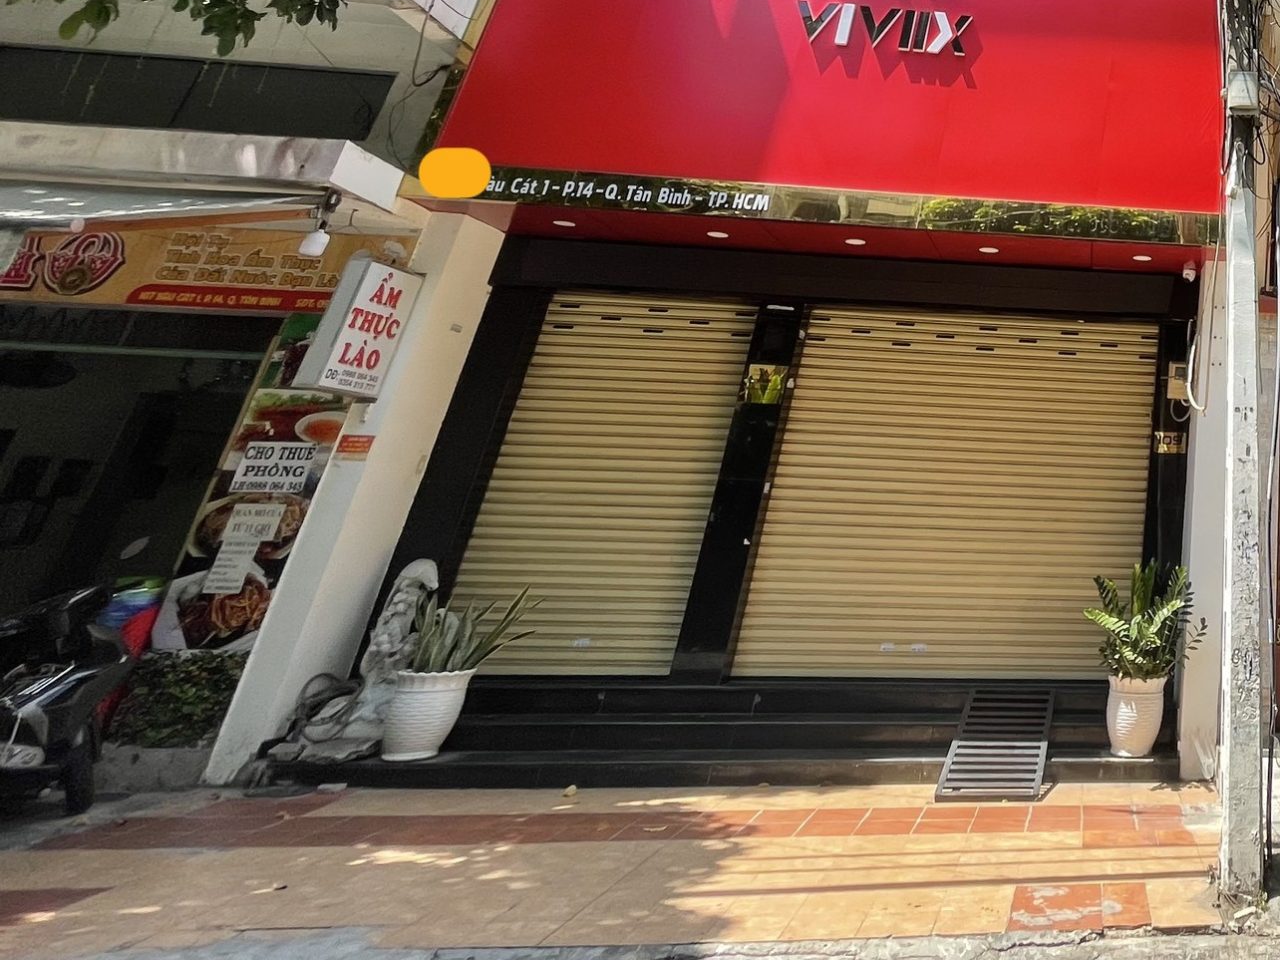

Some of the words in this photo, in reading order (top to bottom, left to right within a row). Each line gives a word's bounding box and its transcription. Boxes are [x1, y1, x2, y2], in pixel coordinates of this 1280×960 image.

[486, 176, 505, 192] àu
[510, 177, 537, 194] Cát
[626, 185, 652, 203] Tân
[657, 187, 691, 206] Bình
[707, 191, 729, 208] TP.
[732, 193, 770, 211] HCM
[203, 251, 241, 266] Hoa
[369, 272, 402, 309] ẨM
[348, 307, 401, 340] THỰC
[338, 339, 381, 370] LÀO
[244, 446, 275, 460] CHO
[279, 443, 316, 461] THUÊ
